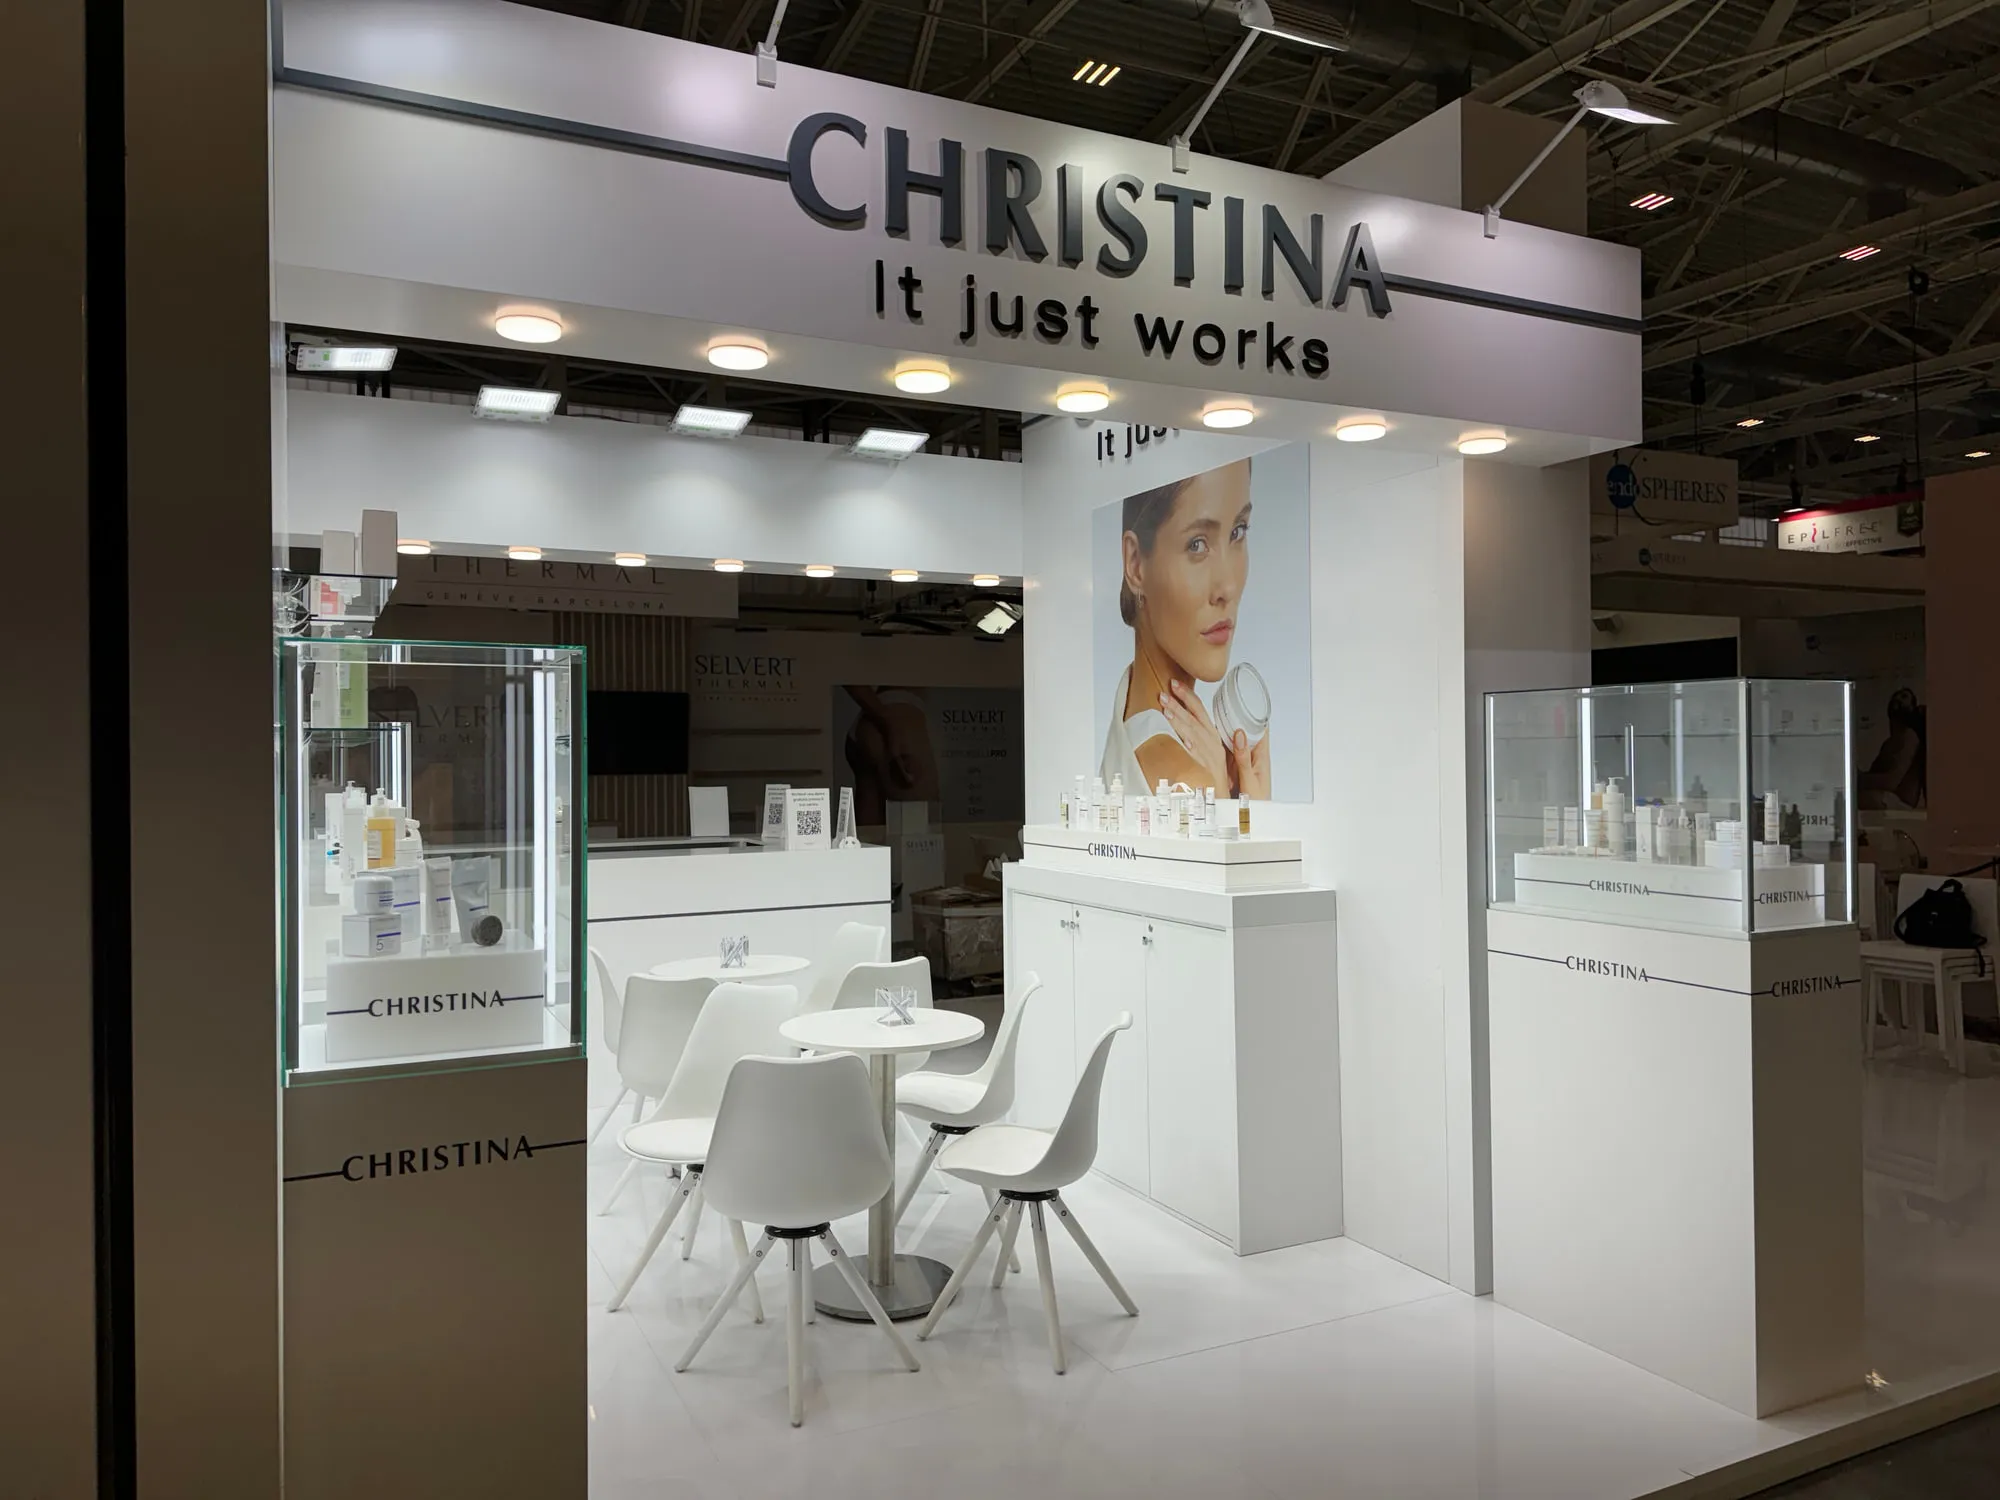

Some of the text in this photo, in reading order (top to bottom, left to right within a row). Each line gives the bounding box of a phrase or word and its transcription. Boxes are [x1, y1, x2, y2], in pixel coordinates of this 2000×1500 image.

[788, 111, 1393, 318] CHRISTINA
[875, 259, 1330, 375] It just works
[1097, 429, 1115, 460] It
[694, 654, 797, 676] SELVERT
[942, 709, 1007, 724] SELVERT
[1087, 842, 1137, 860] CHRISTINA
[1589, 879, 1650, 896] CHRISTINA
[1759, 890, 1811, 905] CHRISTINA
[1565, 955, 1649, 982] CHRISTINA
[1771, 975, 1842, 998] CHRISTINA
[367, 989, 505, 1018] CHRISTINA
[342, 1135, 534, 1181] CHRISTINA
